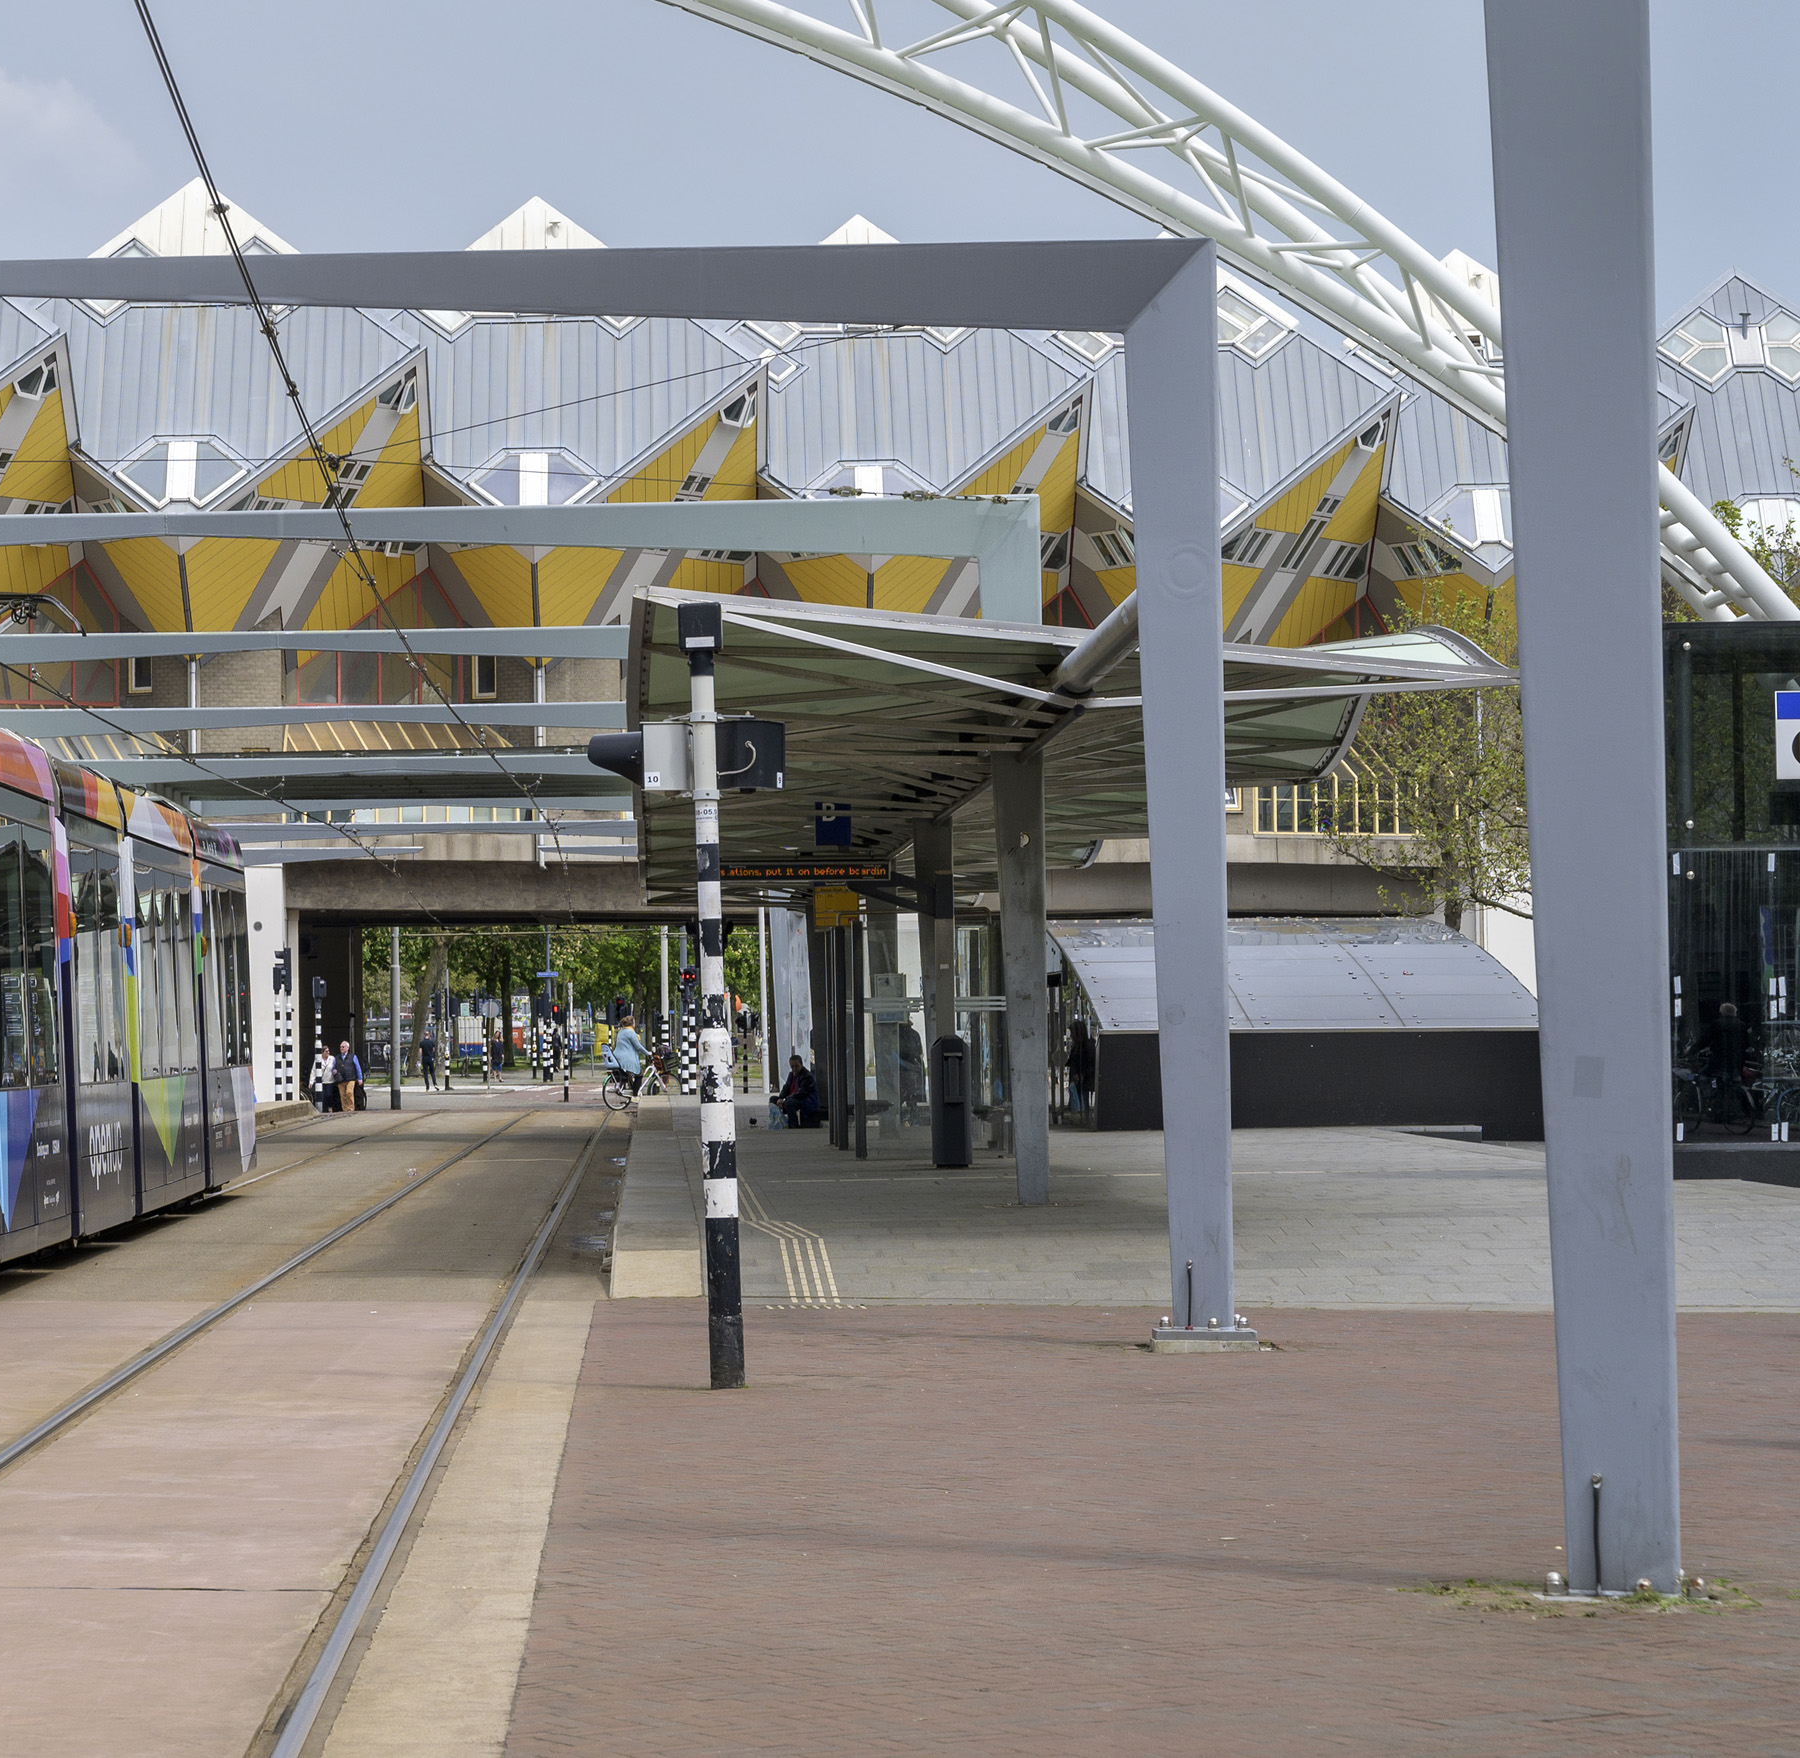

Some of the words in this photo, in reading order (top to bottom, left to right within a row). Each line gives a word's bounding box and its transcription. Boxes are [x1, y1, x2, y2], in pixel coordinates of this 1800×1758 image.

[647, 775, 659, 783] 10
[766, 867, 782, 877] put
[786, 867, 795, 876] it
[798, 868, 811, 876] on
[814, 867, 845, 876] before
